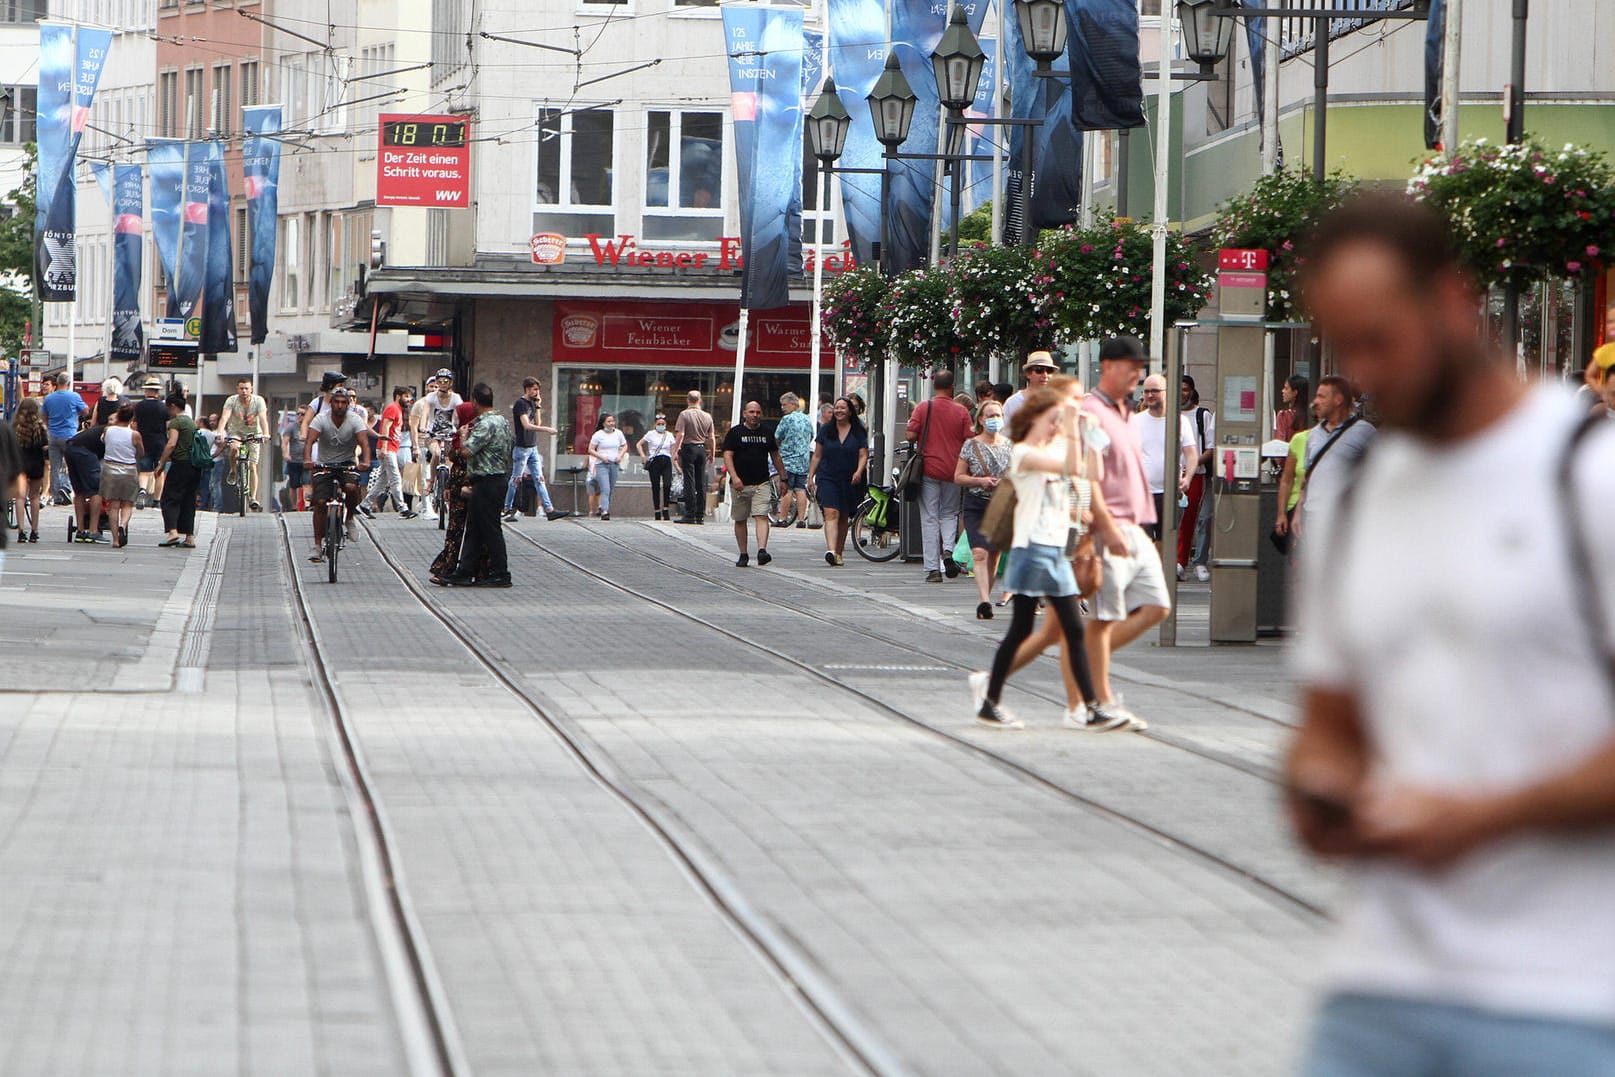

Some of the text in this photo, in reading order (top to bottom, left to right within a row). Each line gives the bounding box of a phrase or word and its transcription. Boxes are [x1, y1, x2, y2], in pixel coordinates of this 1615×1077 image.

[393, 124, 417, 144] 18
[384, 152, 458, 165] Der Zeit einen
[383, 166, 462, 179] Schritt voraus.
[435, 190, 461, 201] WVV
[582, 233, 708, 269] Wiener
[638, 320, 681, 332] Wiener
[765, 323, 806, 336] Warme
[627, 332, 691, 346] Feinbäcker
